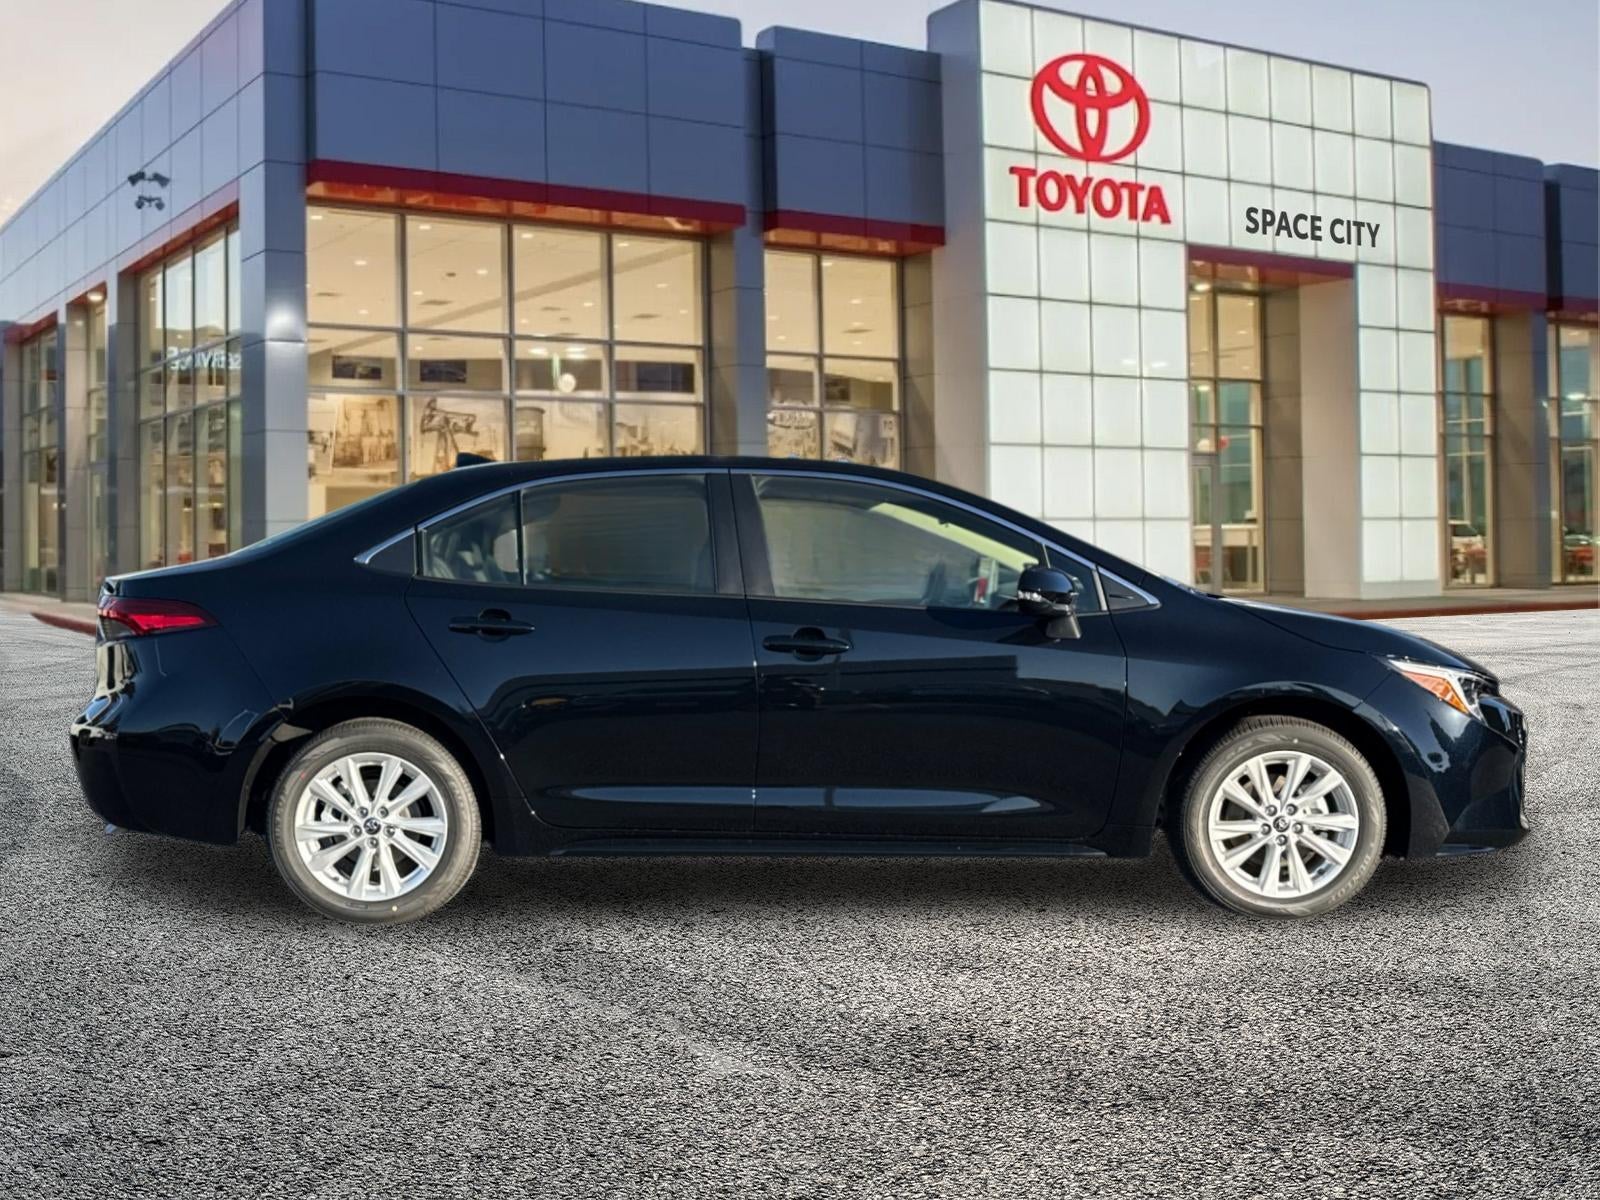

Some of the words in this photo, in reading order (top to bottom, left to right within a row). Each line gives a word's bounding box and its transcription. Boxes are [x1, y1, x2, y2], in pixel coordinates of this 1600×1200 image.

[1010, 166, 1171, 224] TOYOTA
[1245, 206, 1323, 242] SPACE
[1329, 218, 1381, 248] CITY
